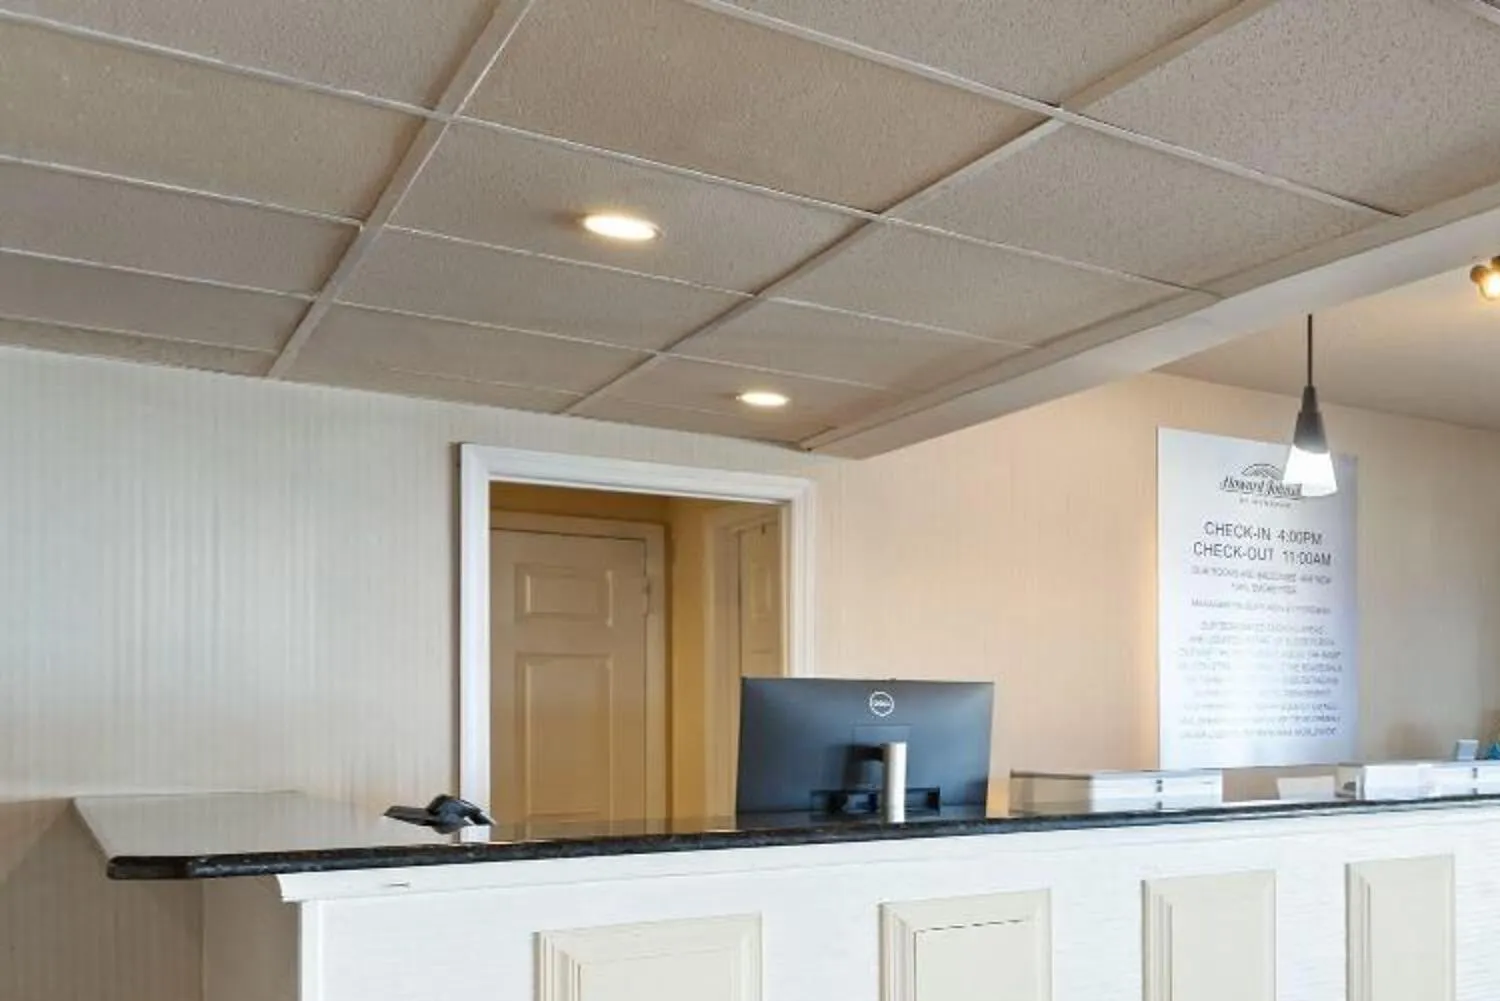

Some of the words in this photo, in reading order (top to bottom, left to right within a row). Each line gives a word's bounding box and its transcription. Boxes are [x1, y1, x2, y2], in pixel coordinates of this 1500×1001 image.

[1203, 521, 1271, 541] CHECK-IN
[1276, 528, 1323, 545] 4:00PM
[1193, 541, 1273, 561] CHECK-OUT
[1283, 551, 1332, 567] 11:00AM
